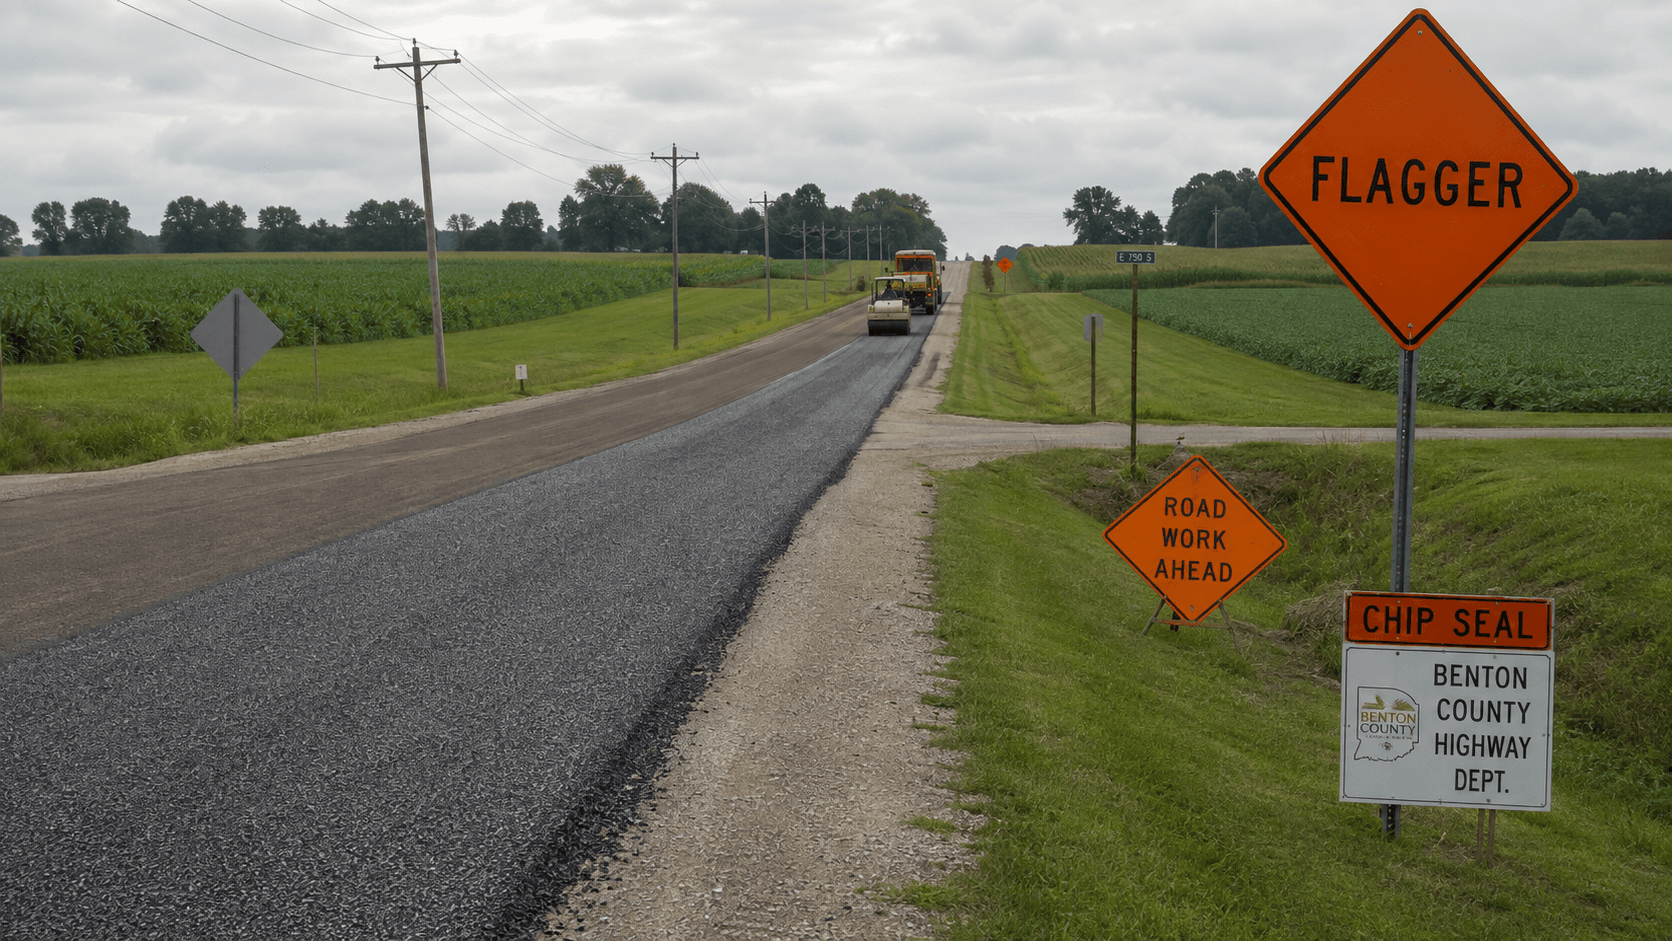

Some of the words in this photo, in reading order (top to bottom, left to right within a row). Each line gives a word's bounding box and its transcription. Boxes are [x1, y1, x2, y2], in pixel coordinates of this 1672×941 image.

[1312, 155, 1523, 209] FLAGGER
[1119, 252, 1125, 262] E
[1128, 252, 1143, 262] 750
[1146, 252, 1152, 262] S
[1164, 496, 1227, 519] ROAD
[1161, 527, 1227, 551] WORK
[1154, 558, 1233, 583] AHEAD
[1363, 604, 1434, 636] CHIP
[1453, 608, 1534, 640] SEAL
[1433, 663, 1528, 690] BENTON
[1360, 711, 1417, 724] BENTON
[1436, 697, 1532, 725] COUNTY
[1360, 723, 1416, 735] COUNTY
[1434, 732, 1532, 760] HIGHWAY
[1454, 768, 1510, 794] DEPT.
